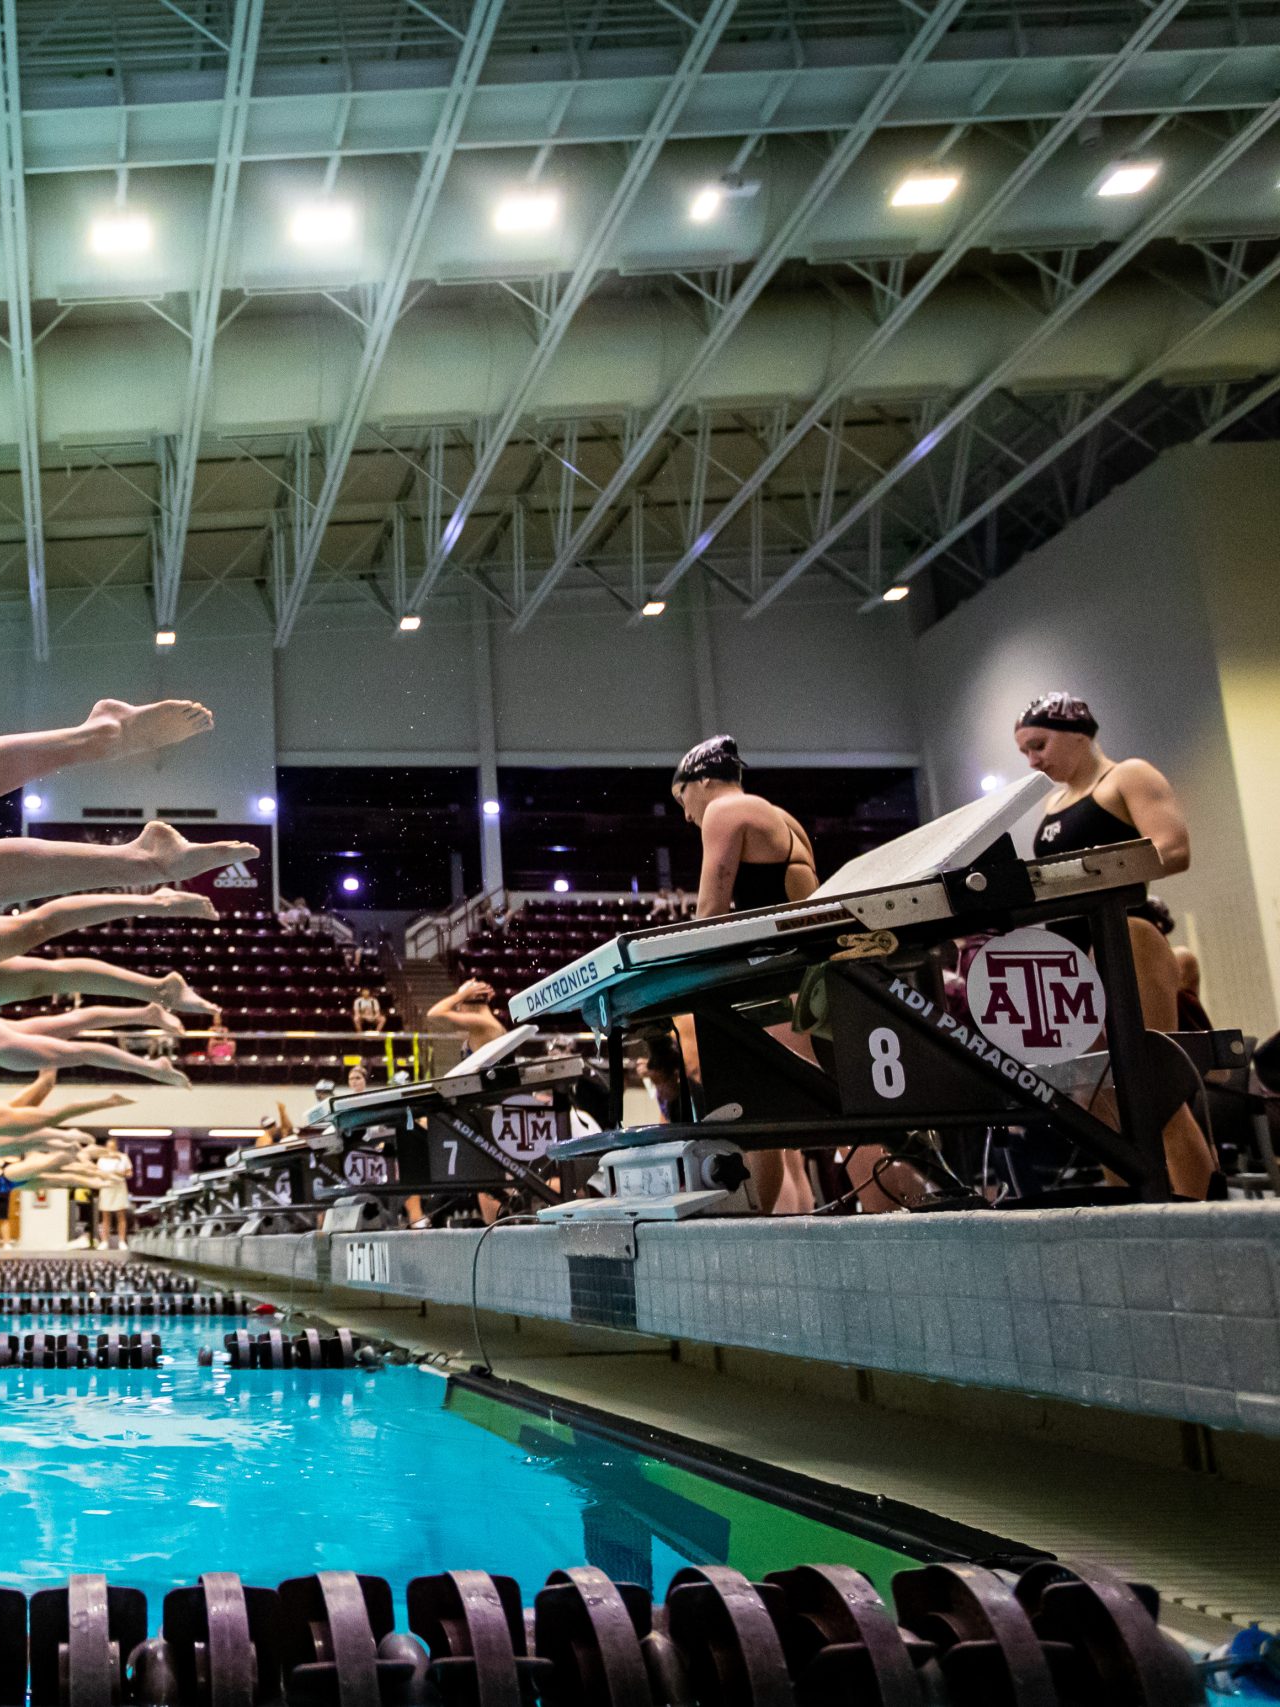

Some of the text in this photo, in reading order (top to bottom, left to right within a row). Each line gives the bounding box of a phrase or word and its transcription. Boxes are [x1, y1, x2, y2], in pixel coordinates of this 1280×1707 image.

[213, 877, 259, 889] adidas
[526, 961, 599, 1012] DAKTRONICS
[599, 995, 608, 1027] 8
[868, 1027, 906, 1099] 8
[888, 978, 1056, 1104] KDI PARAGON
[443, 1141, 458, 1175] 7
[452, 1119, 528, 1178] KDI PARAGON
